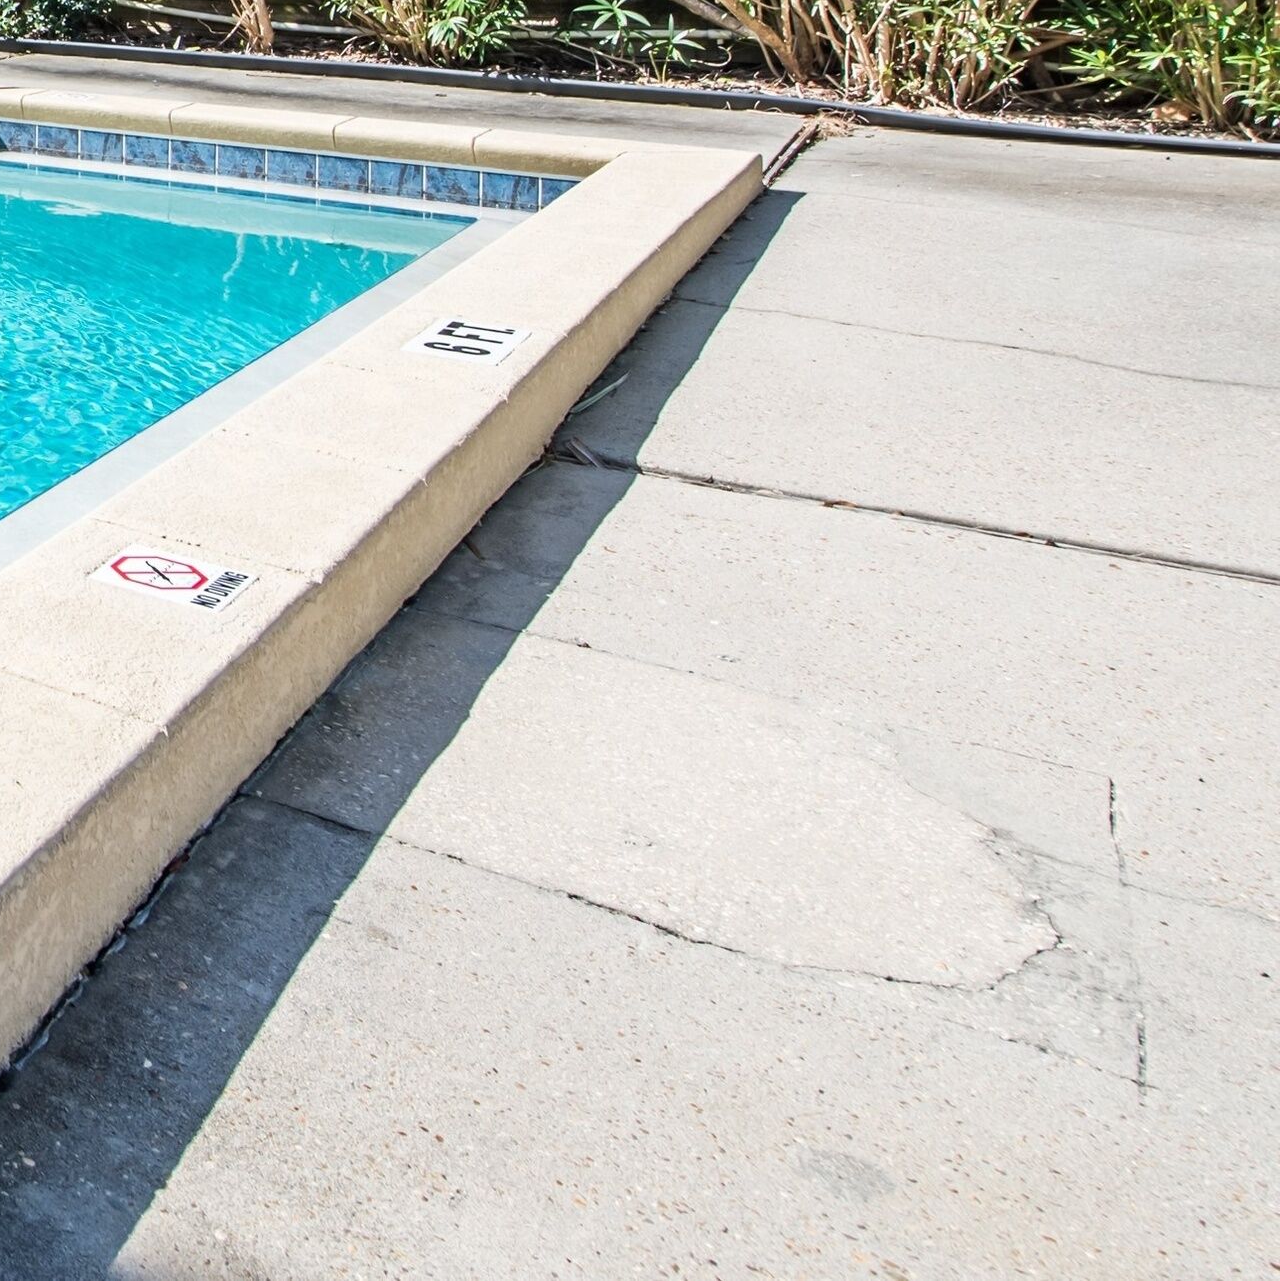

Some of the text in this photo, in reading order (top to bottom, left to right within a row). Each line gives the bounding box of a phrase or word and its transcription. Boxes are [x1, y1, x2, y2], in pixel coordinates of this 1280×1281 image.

[423, 342, 491, 356] 6
[190, 571, 249, 609] NO DIVING
